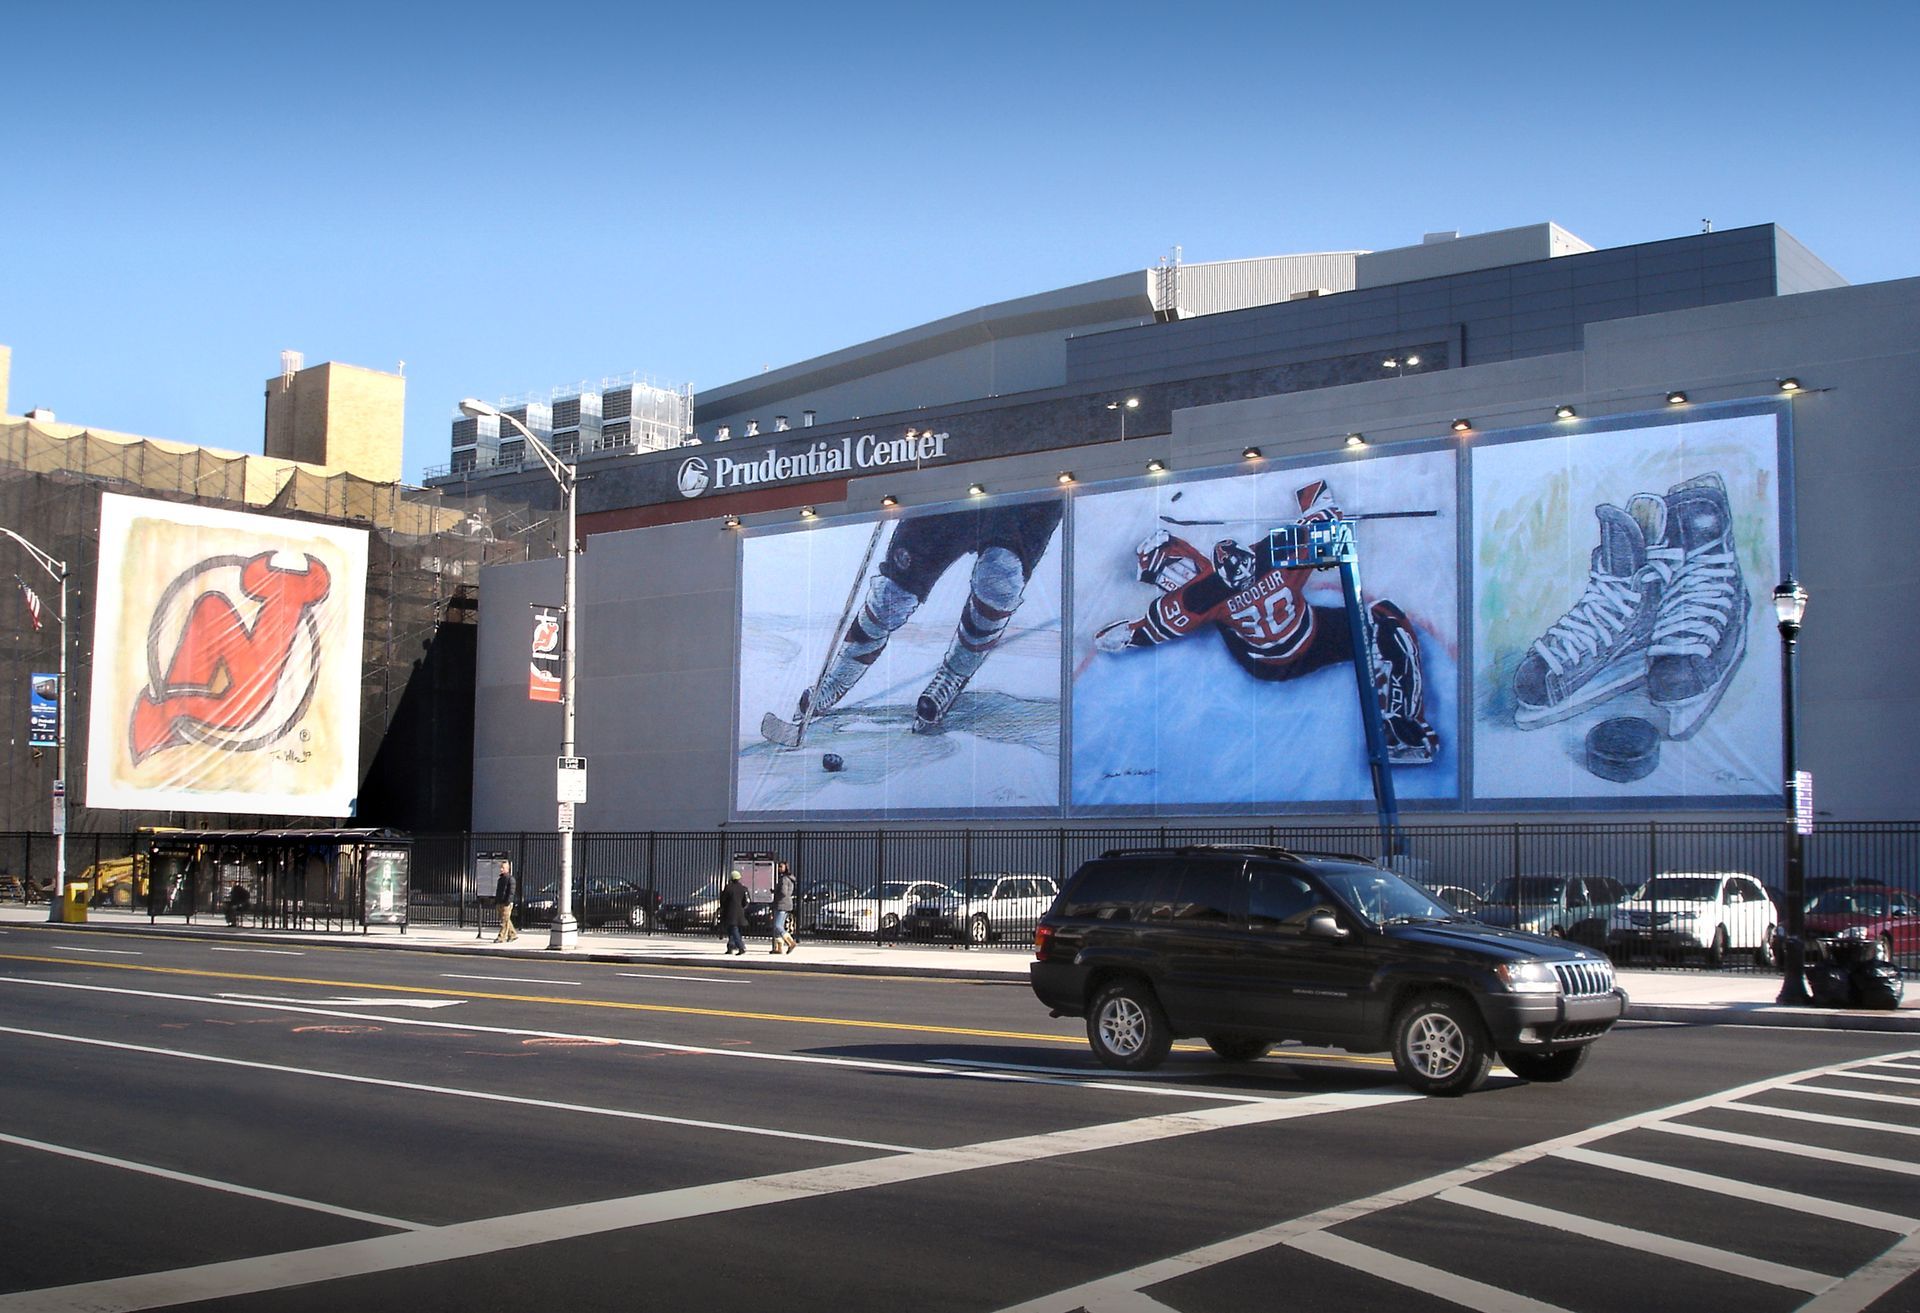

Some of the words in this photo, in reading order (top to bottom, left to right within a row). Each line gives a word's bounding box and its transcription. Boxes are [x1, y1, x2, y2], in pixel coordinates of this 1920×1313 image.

[713, 438, 852, 489] Prudential
[855, 432, 949, 468] Center
[1164, 601, 1190, 627] 30
[1227, 570, 1285, 612] BRODEUR
[1231, 587, 1296, 638] 30
